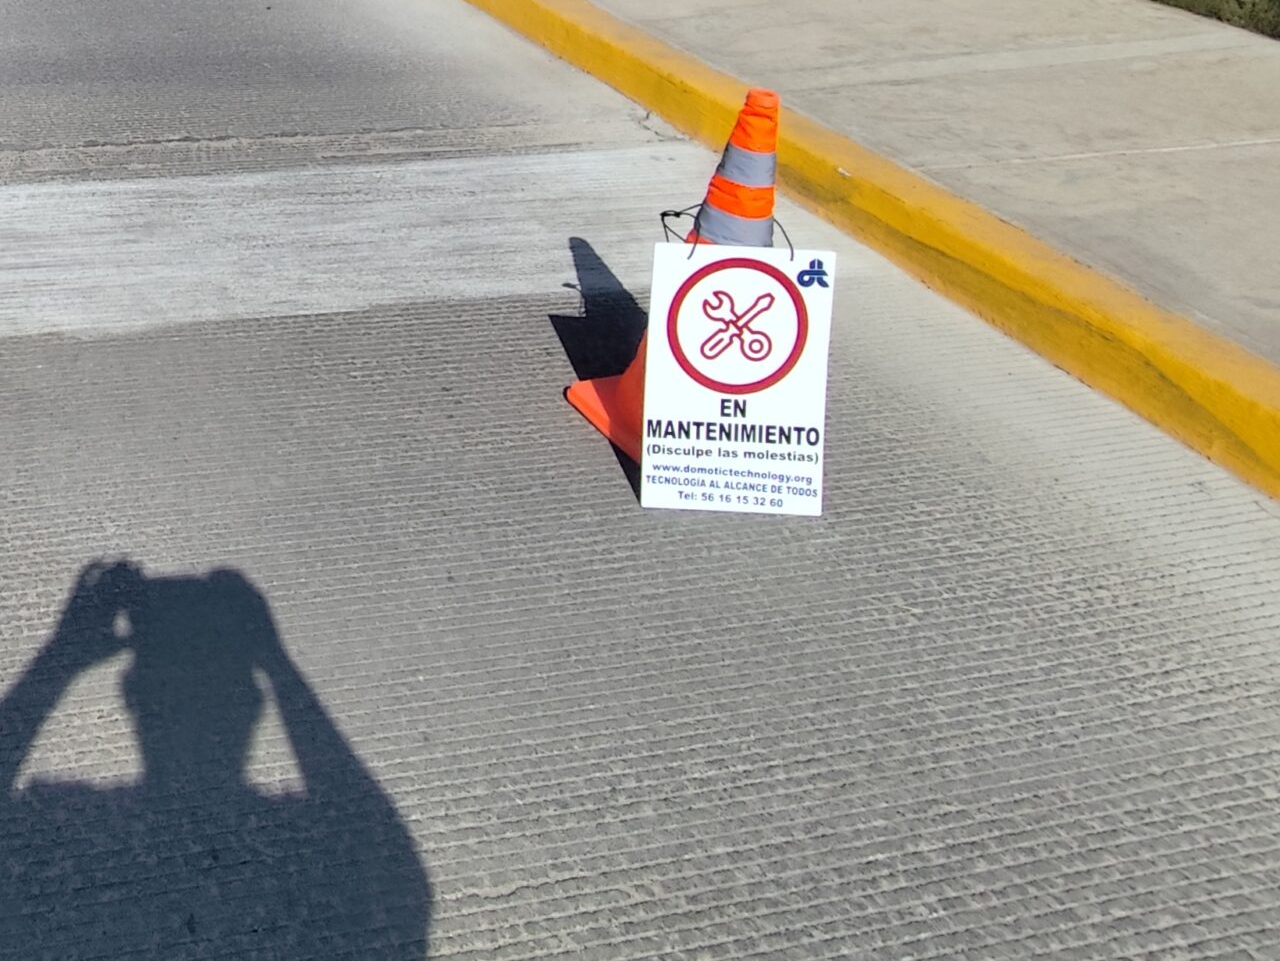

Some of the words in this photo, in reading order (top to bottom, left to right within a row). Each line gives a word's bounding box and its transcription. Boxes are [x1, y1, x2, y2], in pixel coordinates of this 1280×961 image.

[720, 398, 747, 418] EN
[646, 419, 820, 446] MANTENIMIENTO
[646, 444, 713, 458] (Disculpe
[718, 447, 738, 458] las
[743, 450, 819, 465] molestias)
[652, 464, 812, 485] www.domotictechnology.org
[678, 490, 697, 501] Tel:
[701, 492, 714, 502] 56
[719, 494, 731, 503] 16
[736, 495, 749, 505] 15
[753, 496, 766, 506] 32
[769, 498, 783, 508] 60
[709, 480, 721, 489] AL
[723, 481, 767, 493] ALCANCE
[770, 484, 783, 494] DE
[786, 486, 818, 498] TODOS
